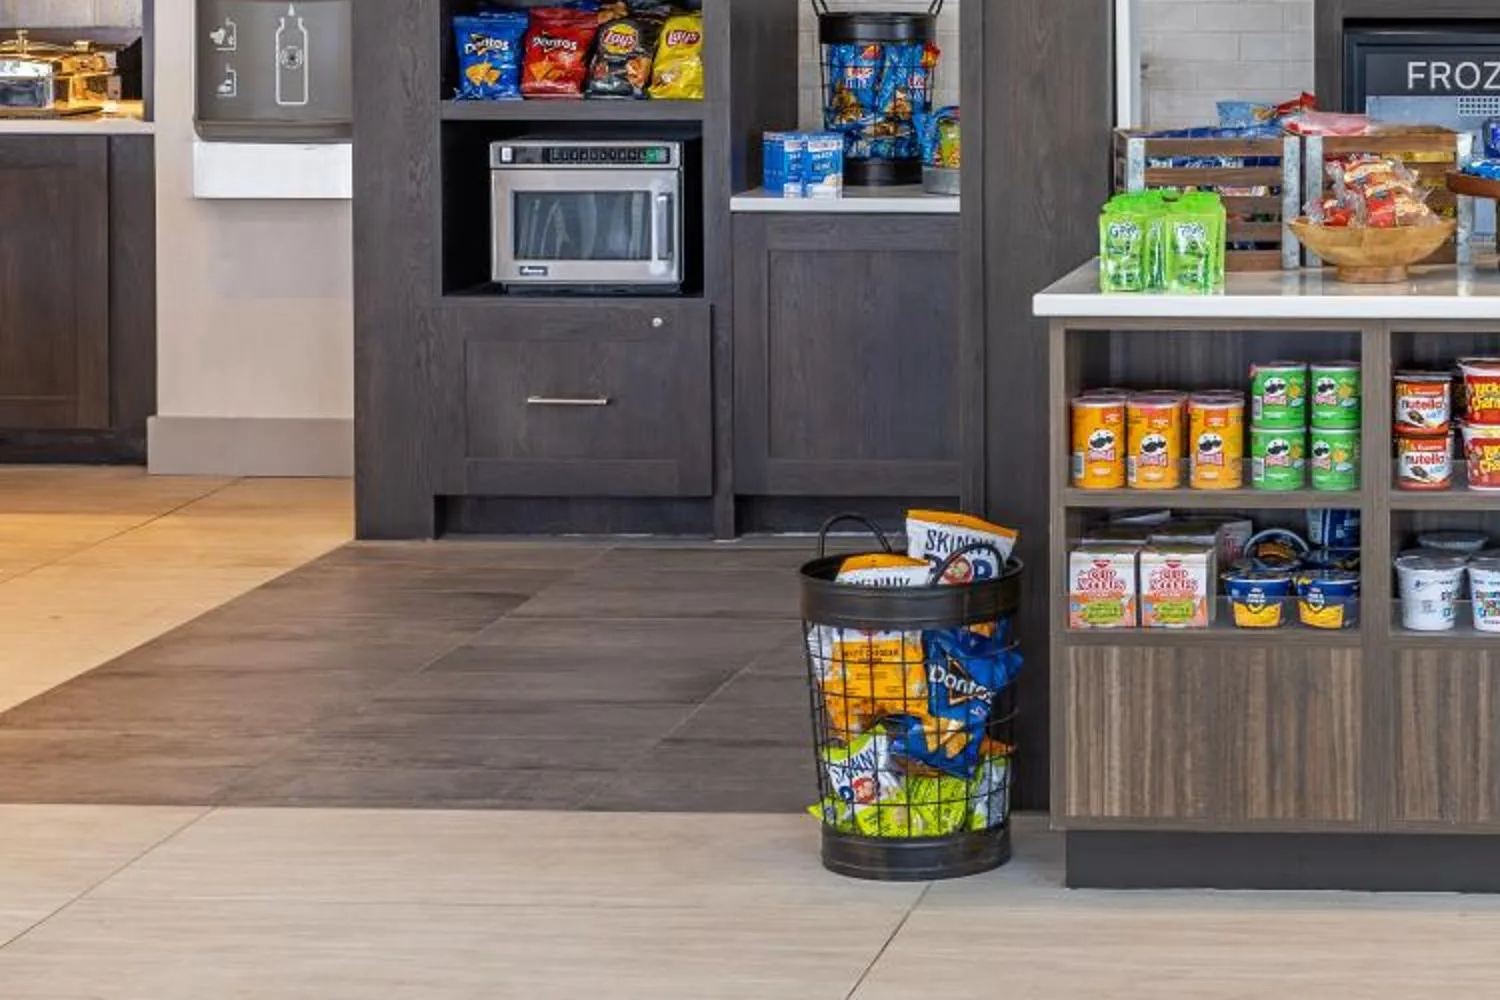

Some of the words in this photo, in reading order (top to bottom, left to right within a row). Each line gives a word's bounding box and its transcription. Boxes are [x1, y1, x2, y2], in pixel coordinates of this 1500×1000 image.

[464, 38, 509, 55] Doritos
[533, 37, 577, 50] Doritos
[1402, 397, 1443, 409] nutella
[1405, 453, 1444, 465] nutella
[929, 663, 994, 705] Doritos
